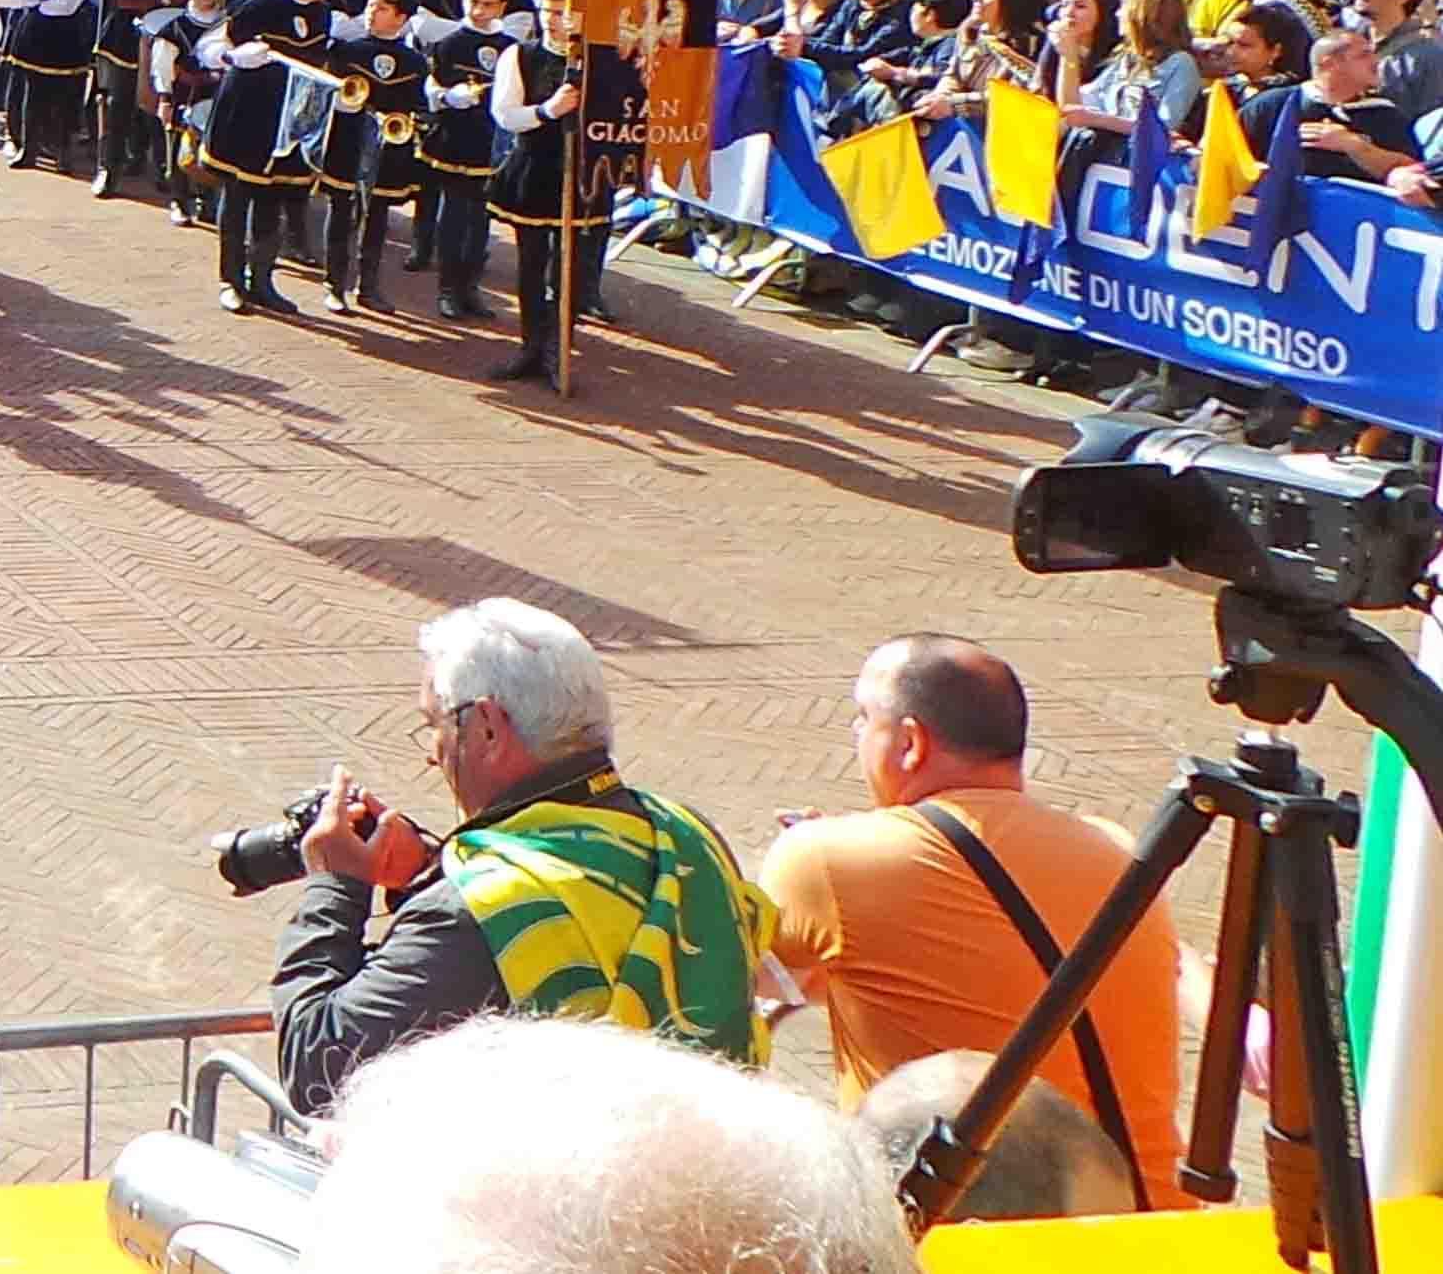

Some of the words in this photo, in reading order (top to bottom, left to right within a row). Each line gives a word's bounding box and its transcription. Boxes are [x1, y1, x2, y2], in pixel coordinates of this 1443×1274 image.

[621, 97, 682, 120] SAN
[586, 121, 709, 144] GIACOMO
[1090, 275, 1122, 312] DI
[1127, 288, 1176, 330] UN
[1181, 299, 1349, 377] SORRISO
